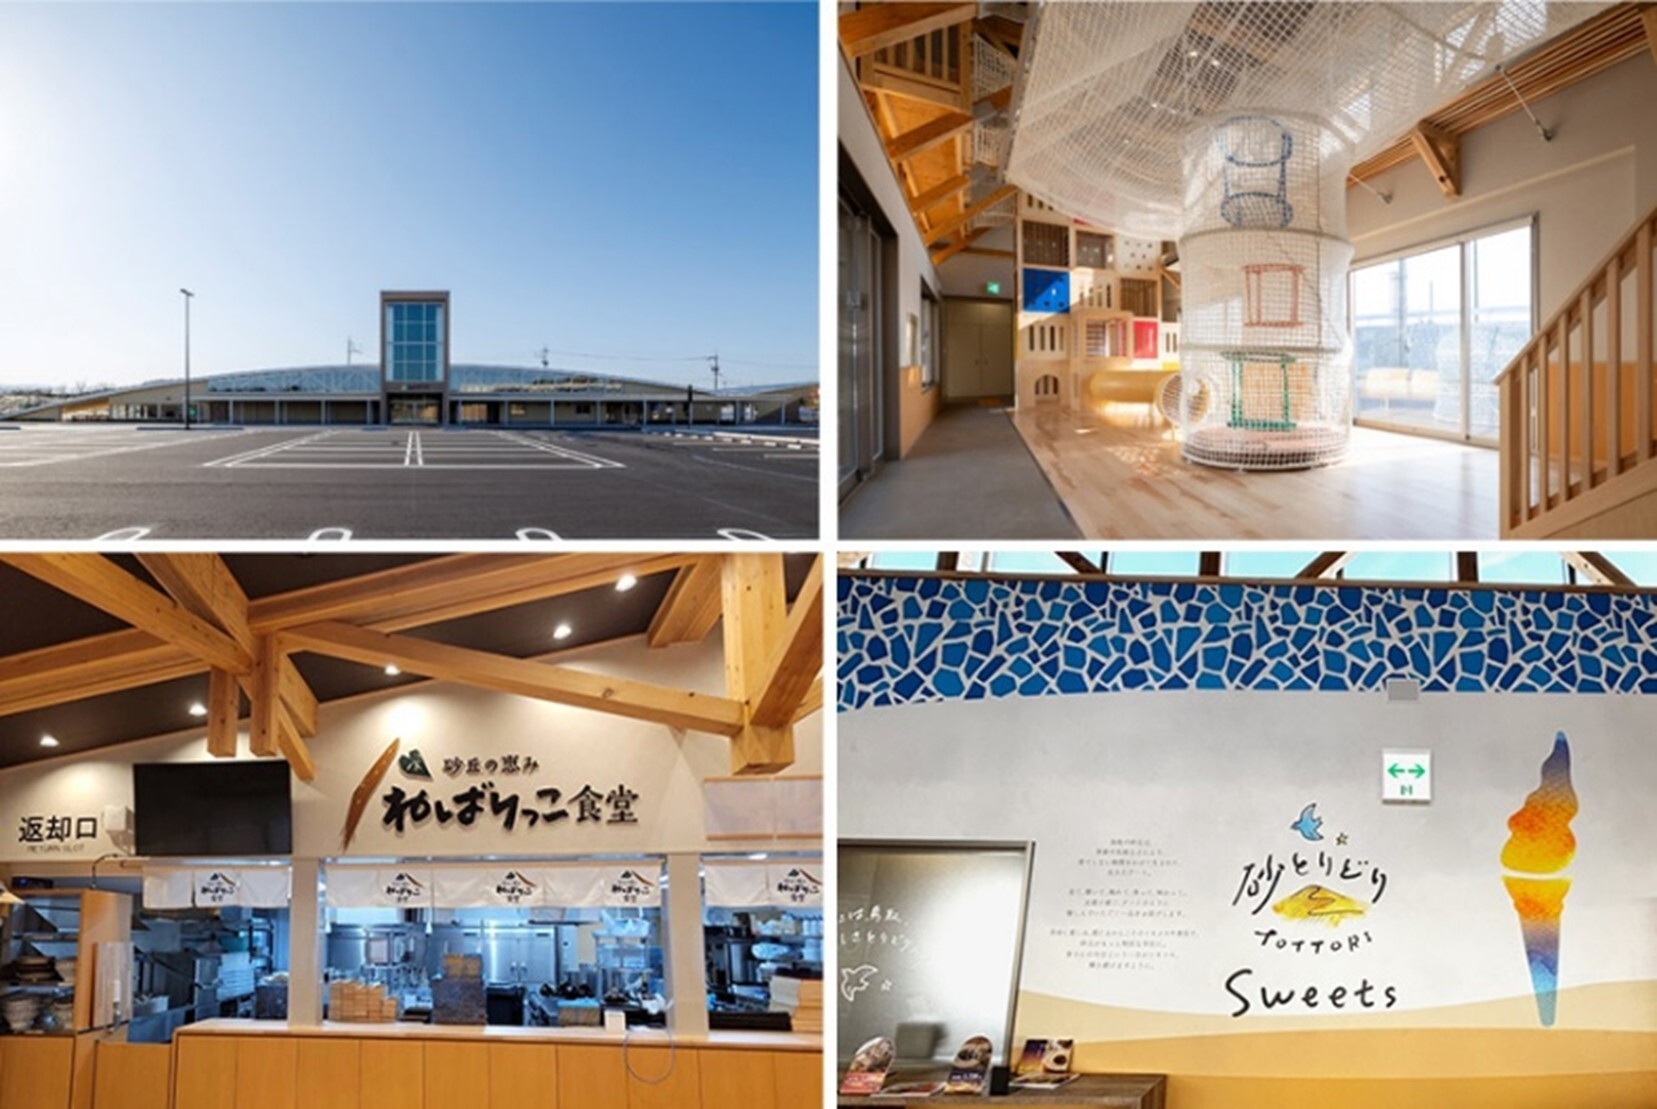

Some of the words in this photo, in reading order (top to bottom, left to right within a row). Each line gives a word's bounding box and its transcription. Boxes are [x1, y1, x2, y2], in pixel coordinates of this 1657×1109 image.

[442, 754, 540, 776] 砂丘の恵み
[381, 781, 640, 832] ねばりっこ食堂
[18, 815, 98, 842] 返却口
[1232, 850, 1388, 915] 砂とりどり
[1254, 928, 1374, 955] TOTTORI
[1224, 968, 1397, 1018] Sweets
